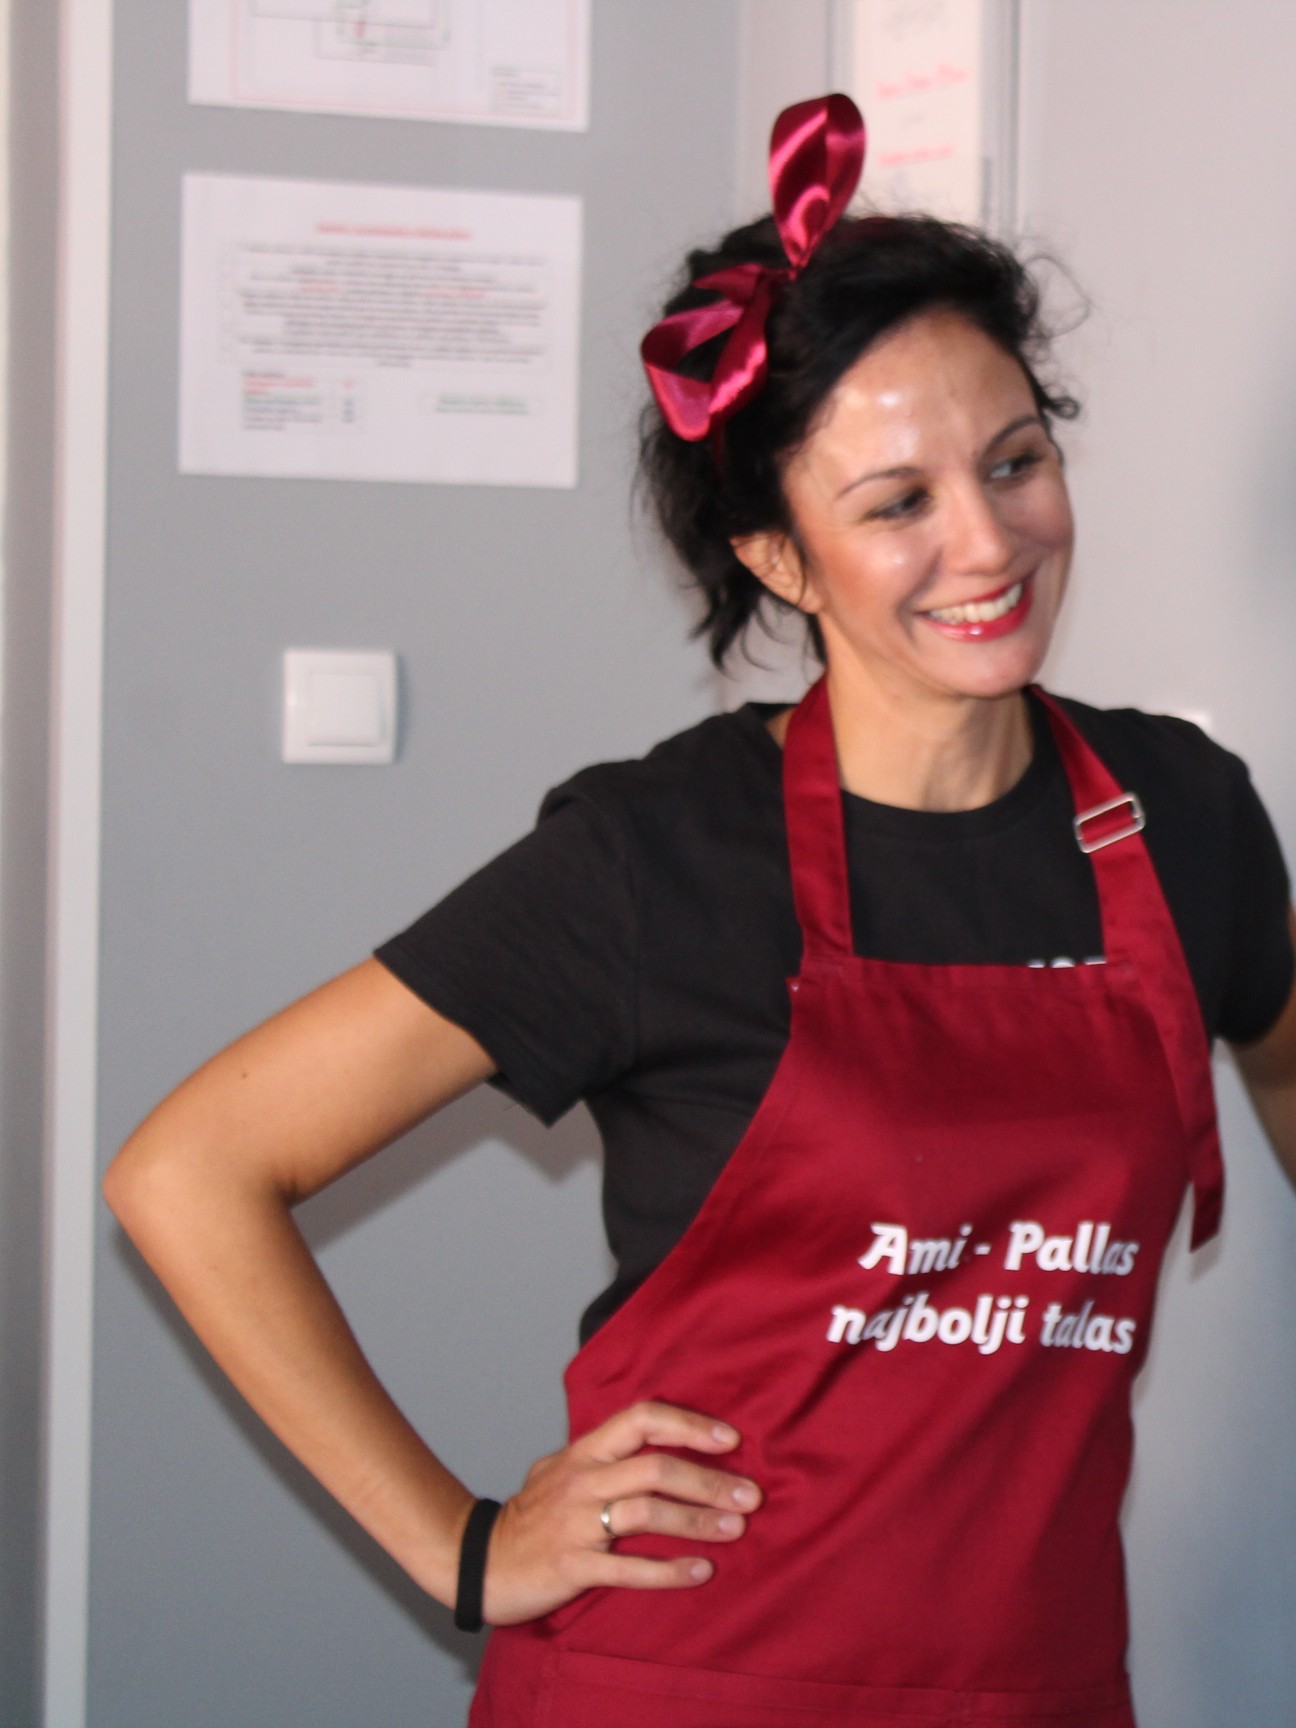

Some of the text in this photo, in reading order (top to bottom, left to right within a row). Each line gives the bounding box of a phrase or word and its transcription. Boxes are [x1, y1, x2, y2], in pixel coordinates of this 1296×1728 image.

[857, 1222, 973, 1275] Ami
[1004, 1220, 1139, 1276] Pallas
[826, 1292, 1136, 1355] najbolji talas
